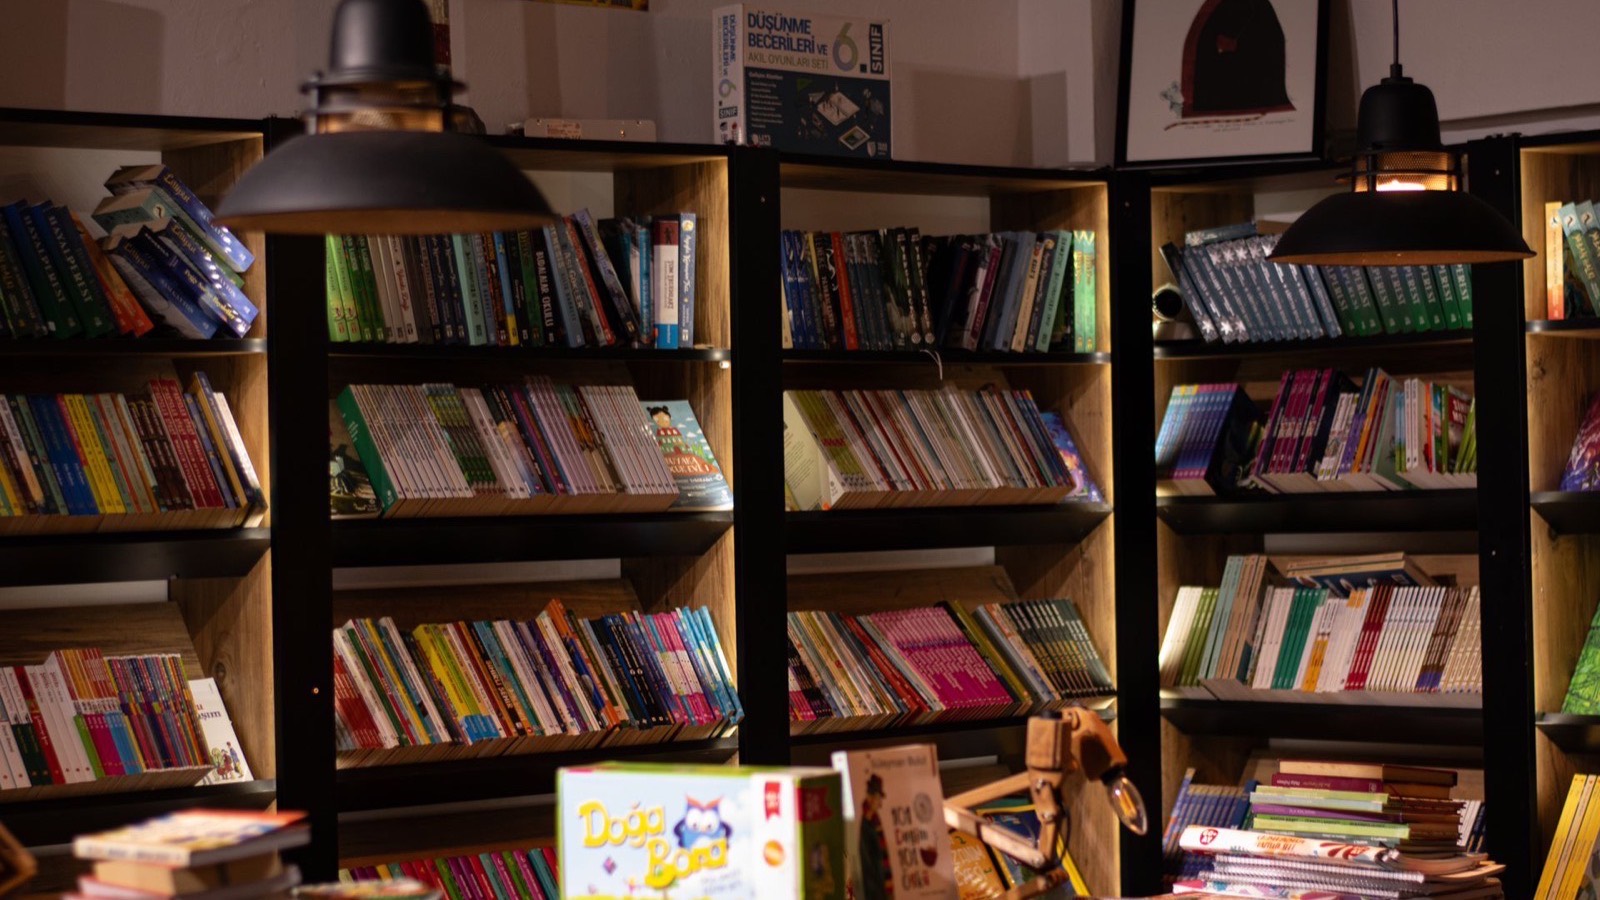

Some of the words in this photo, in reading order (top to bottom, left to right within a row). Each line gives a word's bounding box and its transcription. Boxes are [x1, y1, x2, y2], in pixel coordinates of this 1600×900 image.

[748, 11, 811, 35] DÜŞÜNME
[748, 34, 815, 54] BECERİLERİ
[817, 44, 828, 56] VE
[748, 53, 766, 64] AKIL
[768, 55, 809, 68] OYUNLARI
[811, 57, 829, 70] SETİ
[871, 24, 883, 73] SINIF
[23, 213, 66, 304] HAYALPEREST
[48, 214, 93, 304] HAYALPEREST
[578, 800, 664, 847] Doğa
[645, 837, 729, 888] Bora
